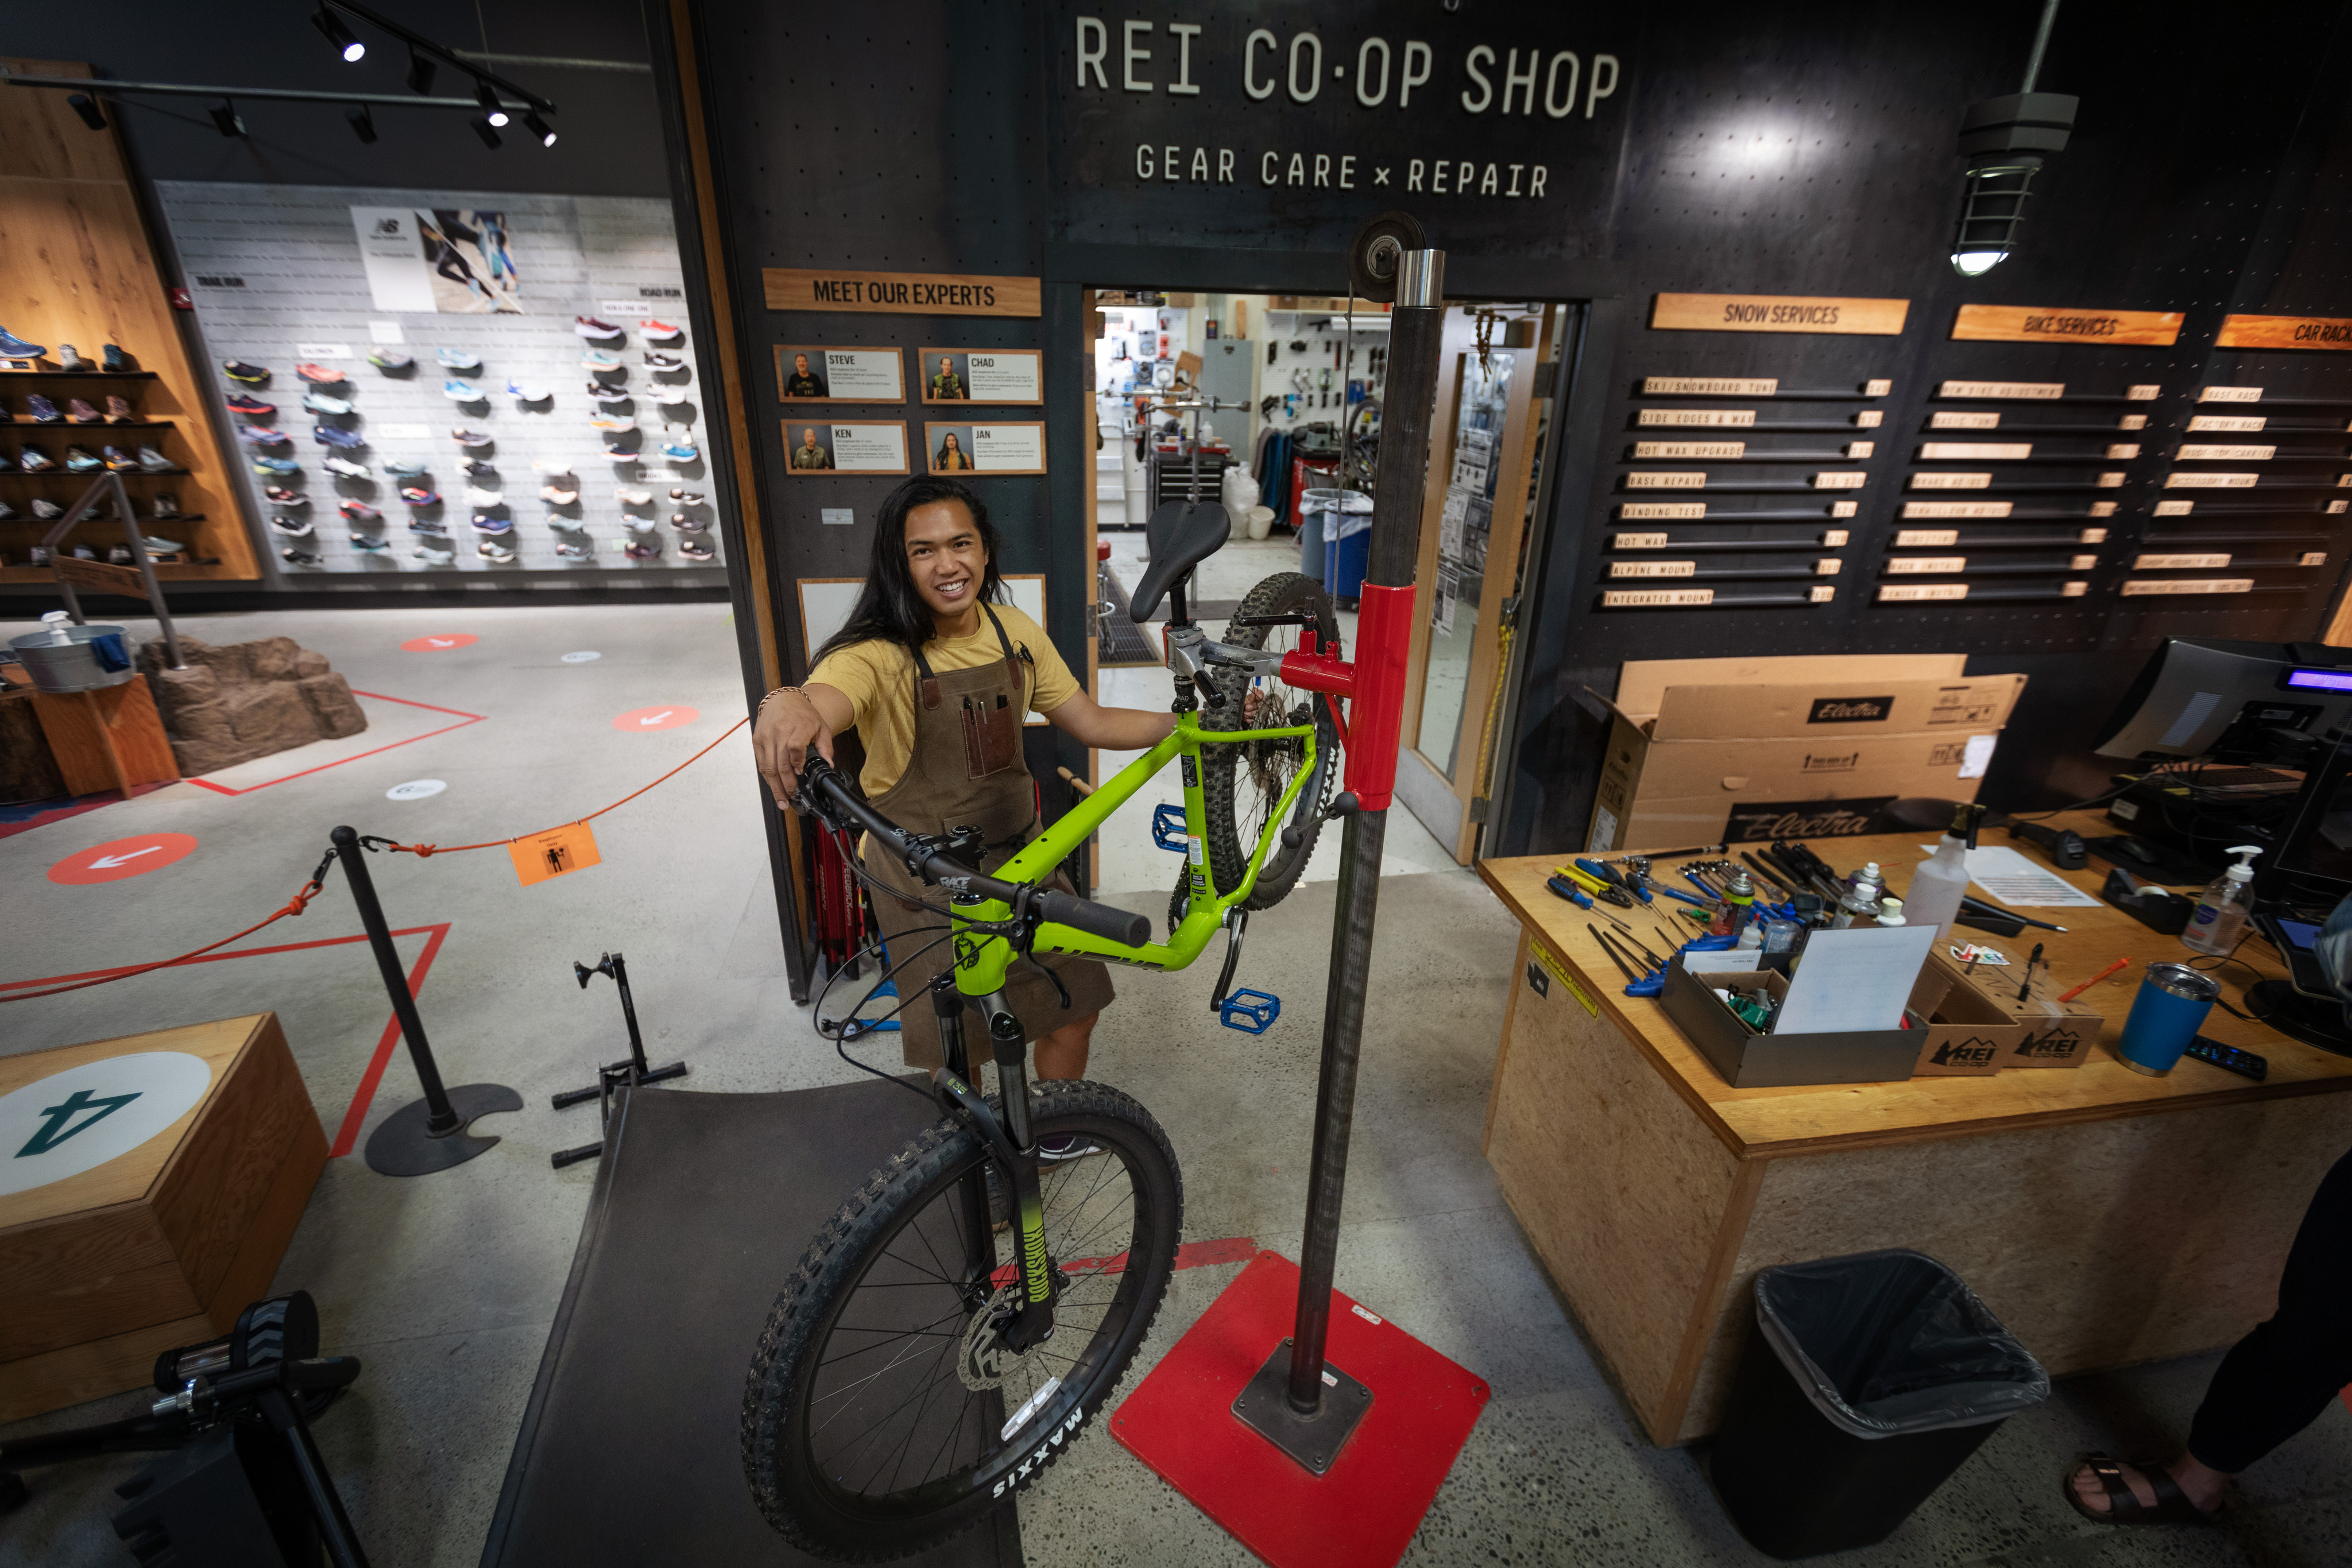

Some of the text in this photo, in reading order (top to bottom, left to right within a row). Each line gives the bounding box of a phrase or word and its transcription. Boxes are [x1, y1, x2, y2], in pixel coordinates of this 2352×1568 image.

[1076, 16, 1202, 95] REI
[1461, 45, 1620, 119] SHOP
[1136, 144, 1236, 183] GEAR
[1261, 150, 1357, 189] CARE
[1407, 158, 1549, 198] REPAIR
[813, 280, 996, 307] MEET OUR EXPERTS
[1724, 304, 1840, 325] SNOW SERVICES
[2023, 315, 2119, 336] BIKE SERVICES
[2295, 324, 2322, 341] CAR
[829, 355, 856, 365] STEVE
[971, 358, 995, 367] CHAD
[1647, 380, 1775, 394] SKI/SNOWBOARD TUNE
[2237, 391, 2260, 401] RACK
[1642, 412, 1669, 424] SIDE
[1676, 413, 1710, 424] EDGES
[1732, 414, 1754, 425] WAX
[834, 429, 852, 438] KEN
[976, 430, 991, 439] JAN
[1637, 445, 1744, 456] HOT WAX UPGRADE
[1629, 476, 1705, 487] BASE REPAIR
[1624, 507, 1704, 517] BINDING TEST
[1616, 537, 1667, 547] HOT WAX
[1613, 564, 1695, 575] ALPINE MOUNT
[1607, 593, 1713, 604] INTEGRATED MOUNT
[1817, 702, 1882, 719] Electra
[1740, 811, 1869, 839] Electra
[538, 834, 563, 843] Employees
[844, 861, 853, 909] FEEDBACK
[2041, 1039, 2082, 1052] REI
[1955, 1047, 1998, 1062] REI
[13, 1089, 144, 1160] 4
[1023, 1223, 1050, 1303] ROCKSHOX
[993, 1406, 1083, 1499] MAXXIS
